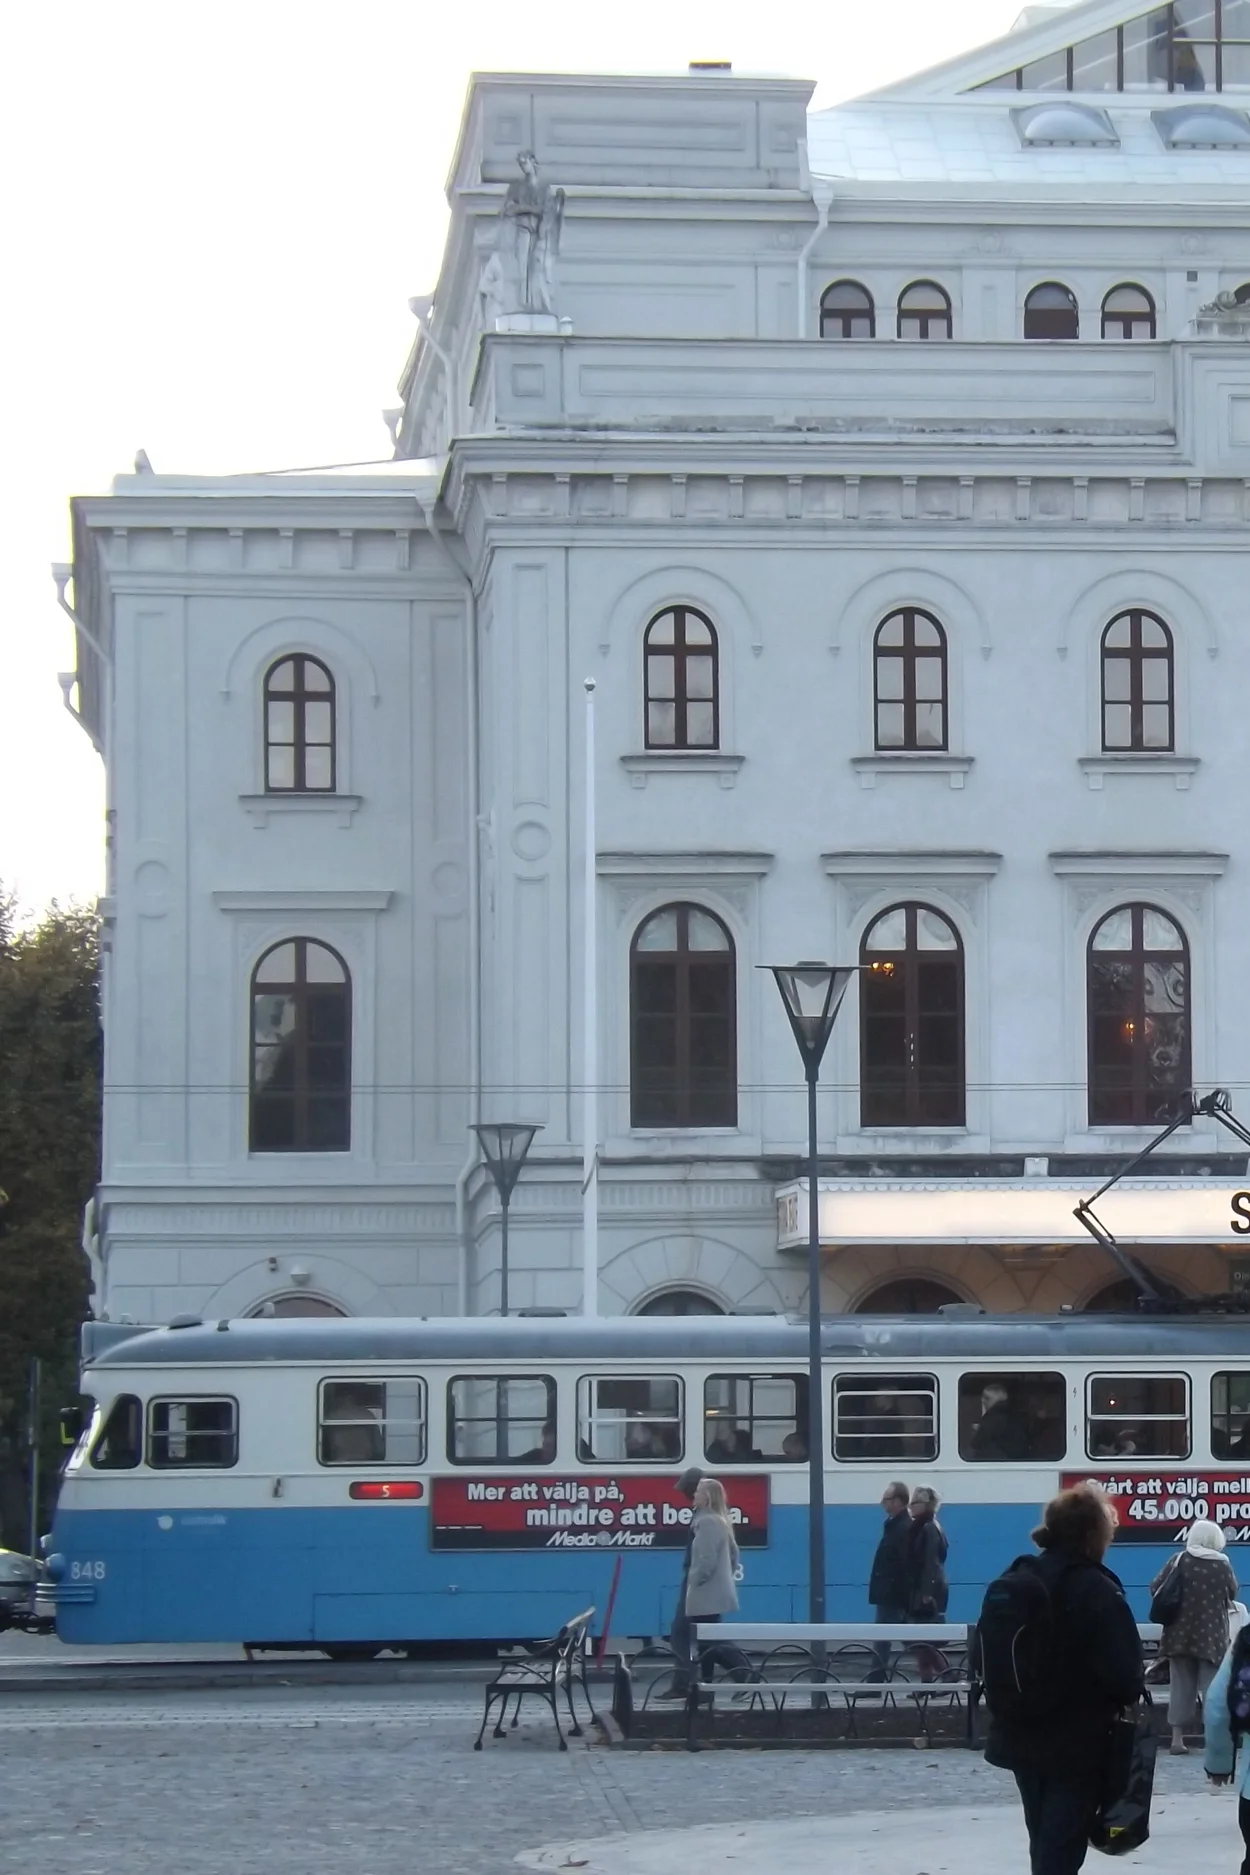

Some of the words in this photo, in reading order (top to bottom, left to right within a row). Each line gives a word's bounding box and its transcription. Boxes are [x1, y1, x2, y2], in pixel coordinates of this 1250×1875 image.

[468, 1482, 505, 1500] Mer
[510, 1482, 539, 1500] att
[543, 1481, 589, 1502] välja
[595, 1480, 625, 1502] på,
[1136, 1478, 1162, 1495] att
[1166, 1478, 1209, 1498] välja
[526, 1503, 614, 1526] mindre
[620, 1503, 656, 1525] att
[663, 1502, 749, 1525] bea.
[1128, 1499, 1209, 1520] 45.000
[546, 1531, 597, 1546] Media
[607, 1530, 656, 1546] Markt
[70, 1561, 106, 1580] 848
